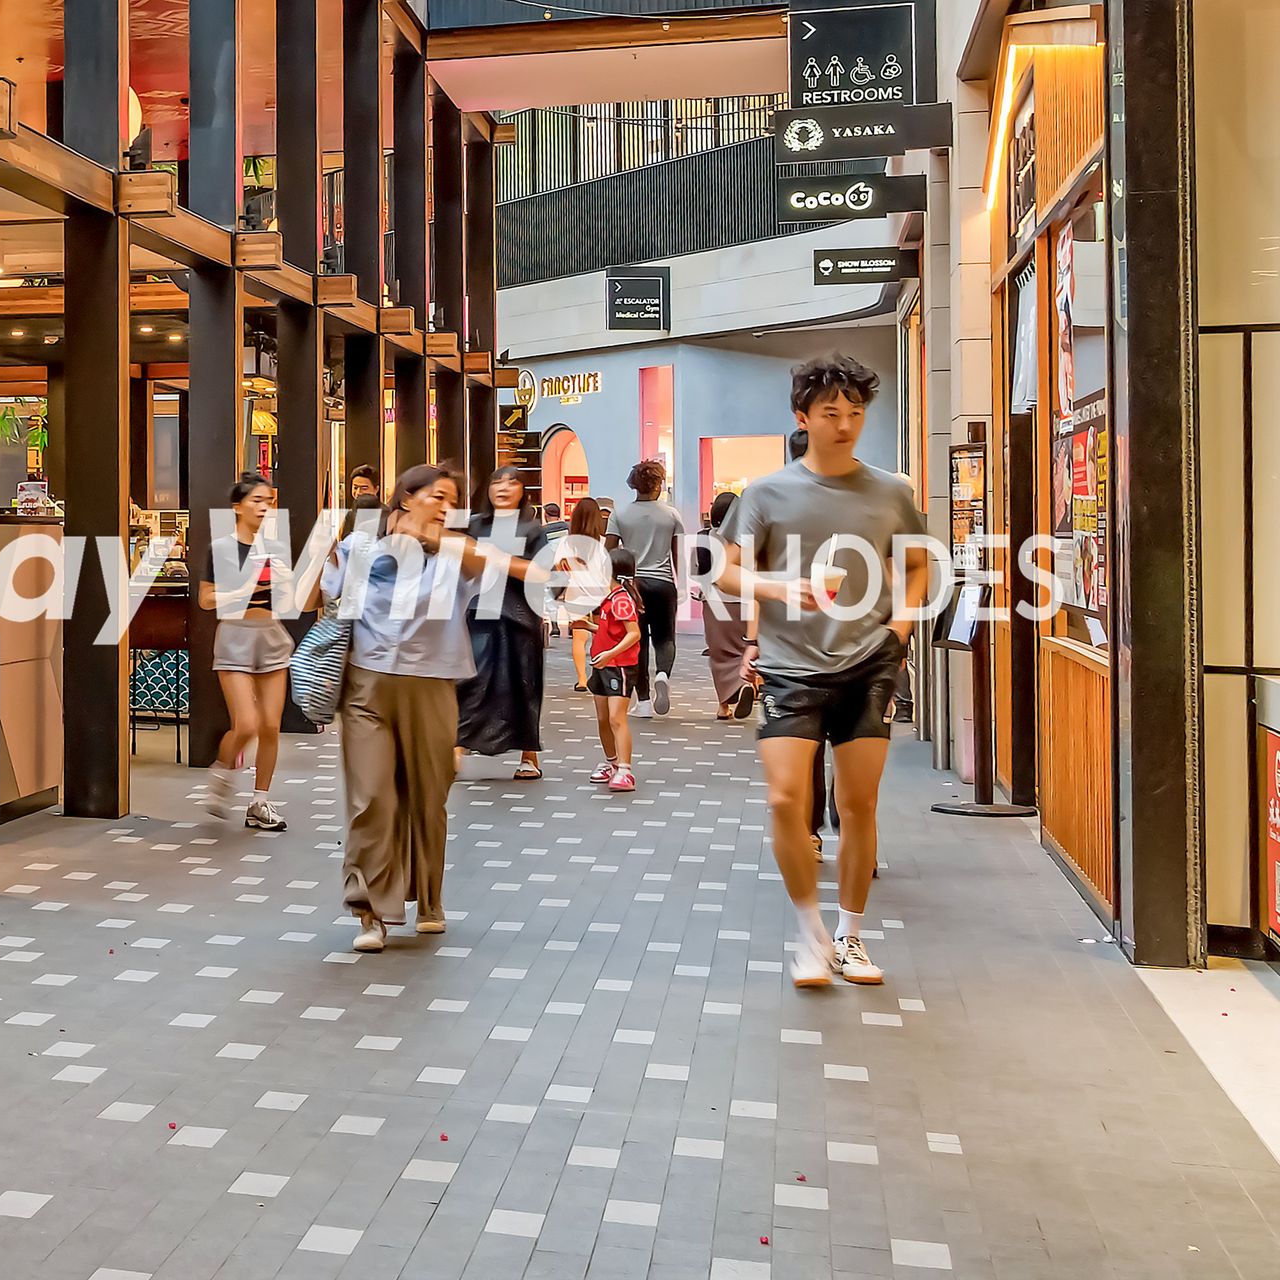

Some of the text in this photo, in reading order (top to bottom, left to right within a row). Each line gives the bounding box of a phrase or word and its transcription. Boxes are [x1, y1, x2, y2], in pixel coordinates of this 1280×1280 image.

[802, 86, 903, 105] RESTROOMS
[831, 125, 896, 138] YASAKA
[837, 259, 896, 268] SNOW BLOSSOM
[645, 305, 660, 313] Gym
